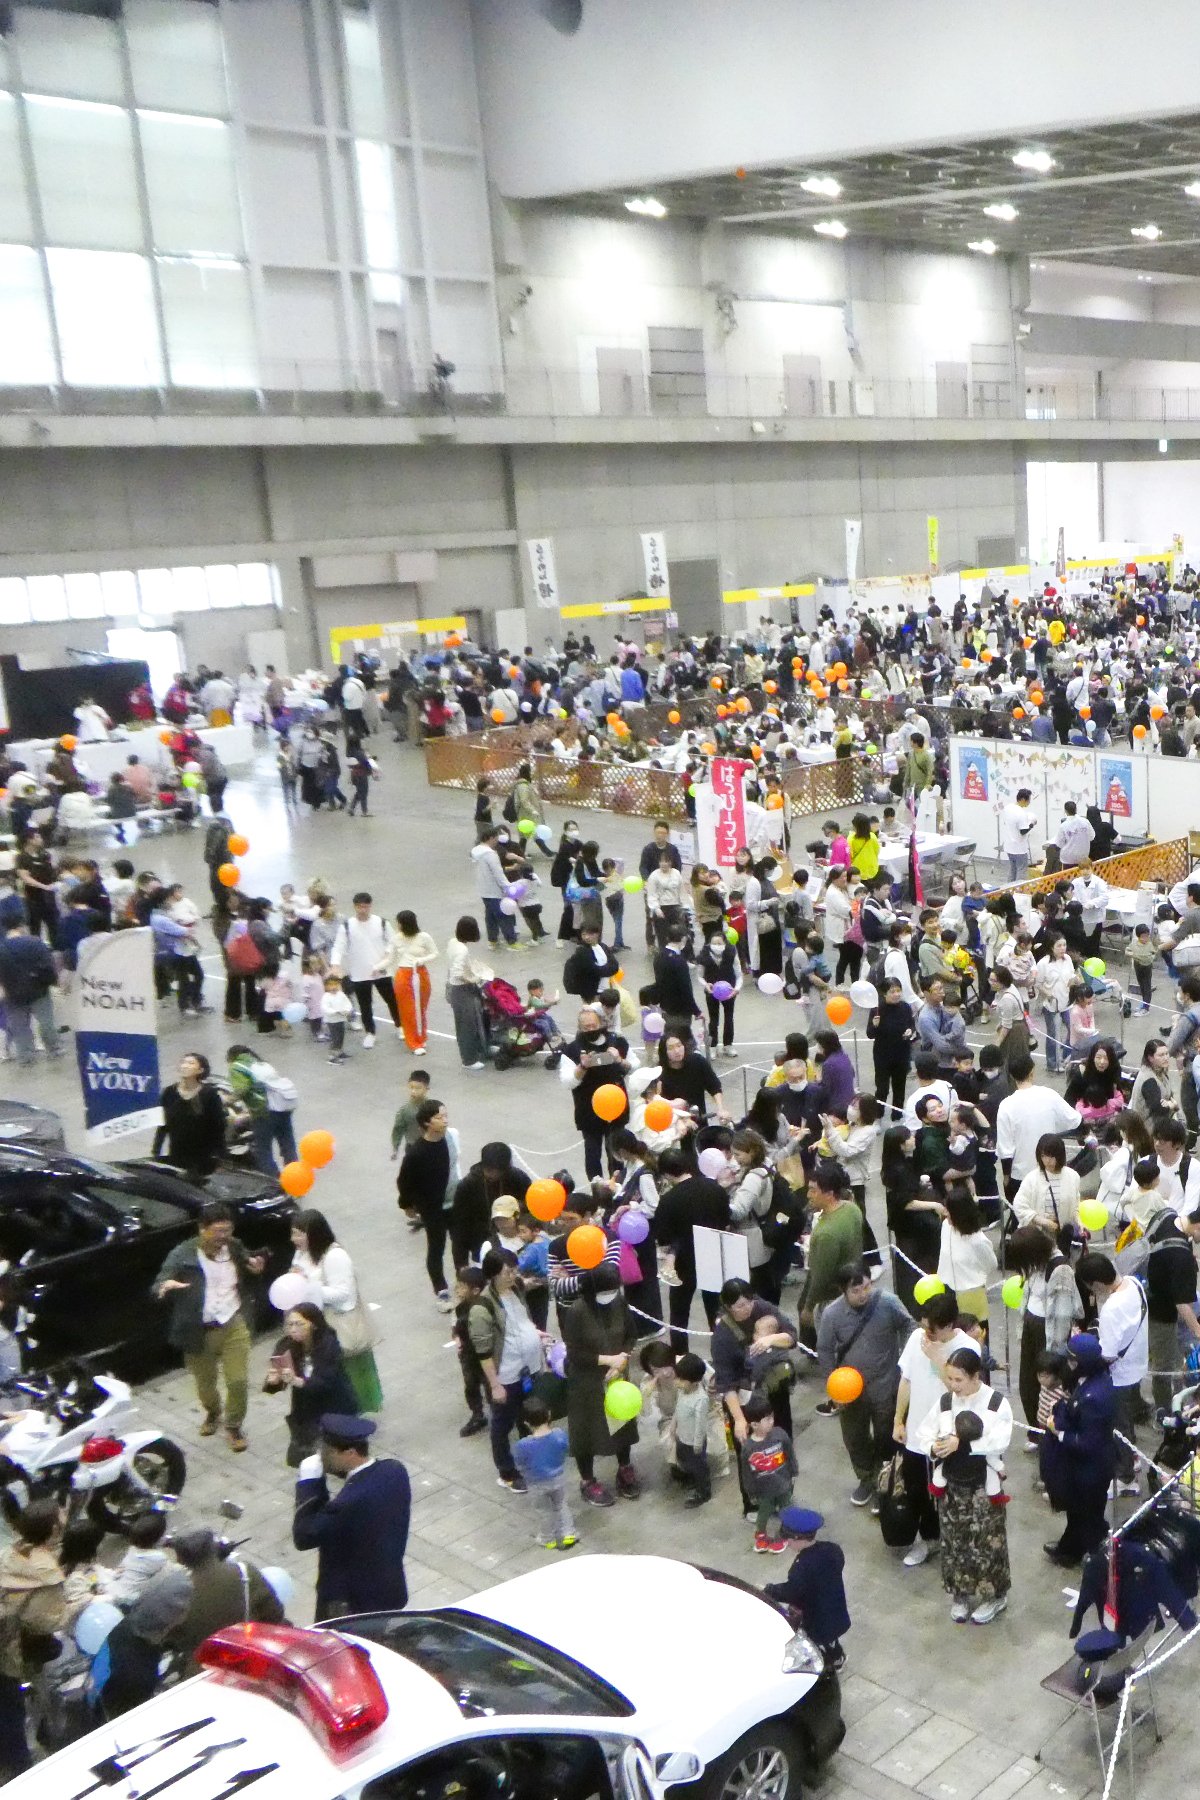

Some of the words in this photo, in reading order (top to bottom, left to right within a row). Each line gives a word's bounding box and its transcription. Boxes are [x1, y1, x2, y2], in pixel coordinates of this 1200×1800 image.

[81, 976, 122, 991] New
[83, 994, 145, 1012] NOAH
[87, 1052, 133, 1070] New
[87, 1072, 152, 1092] VOXY
